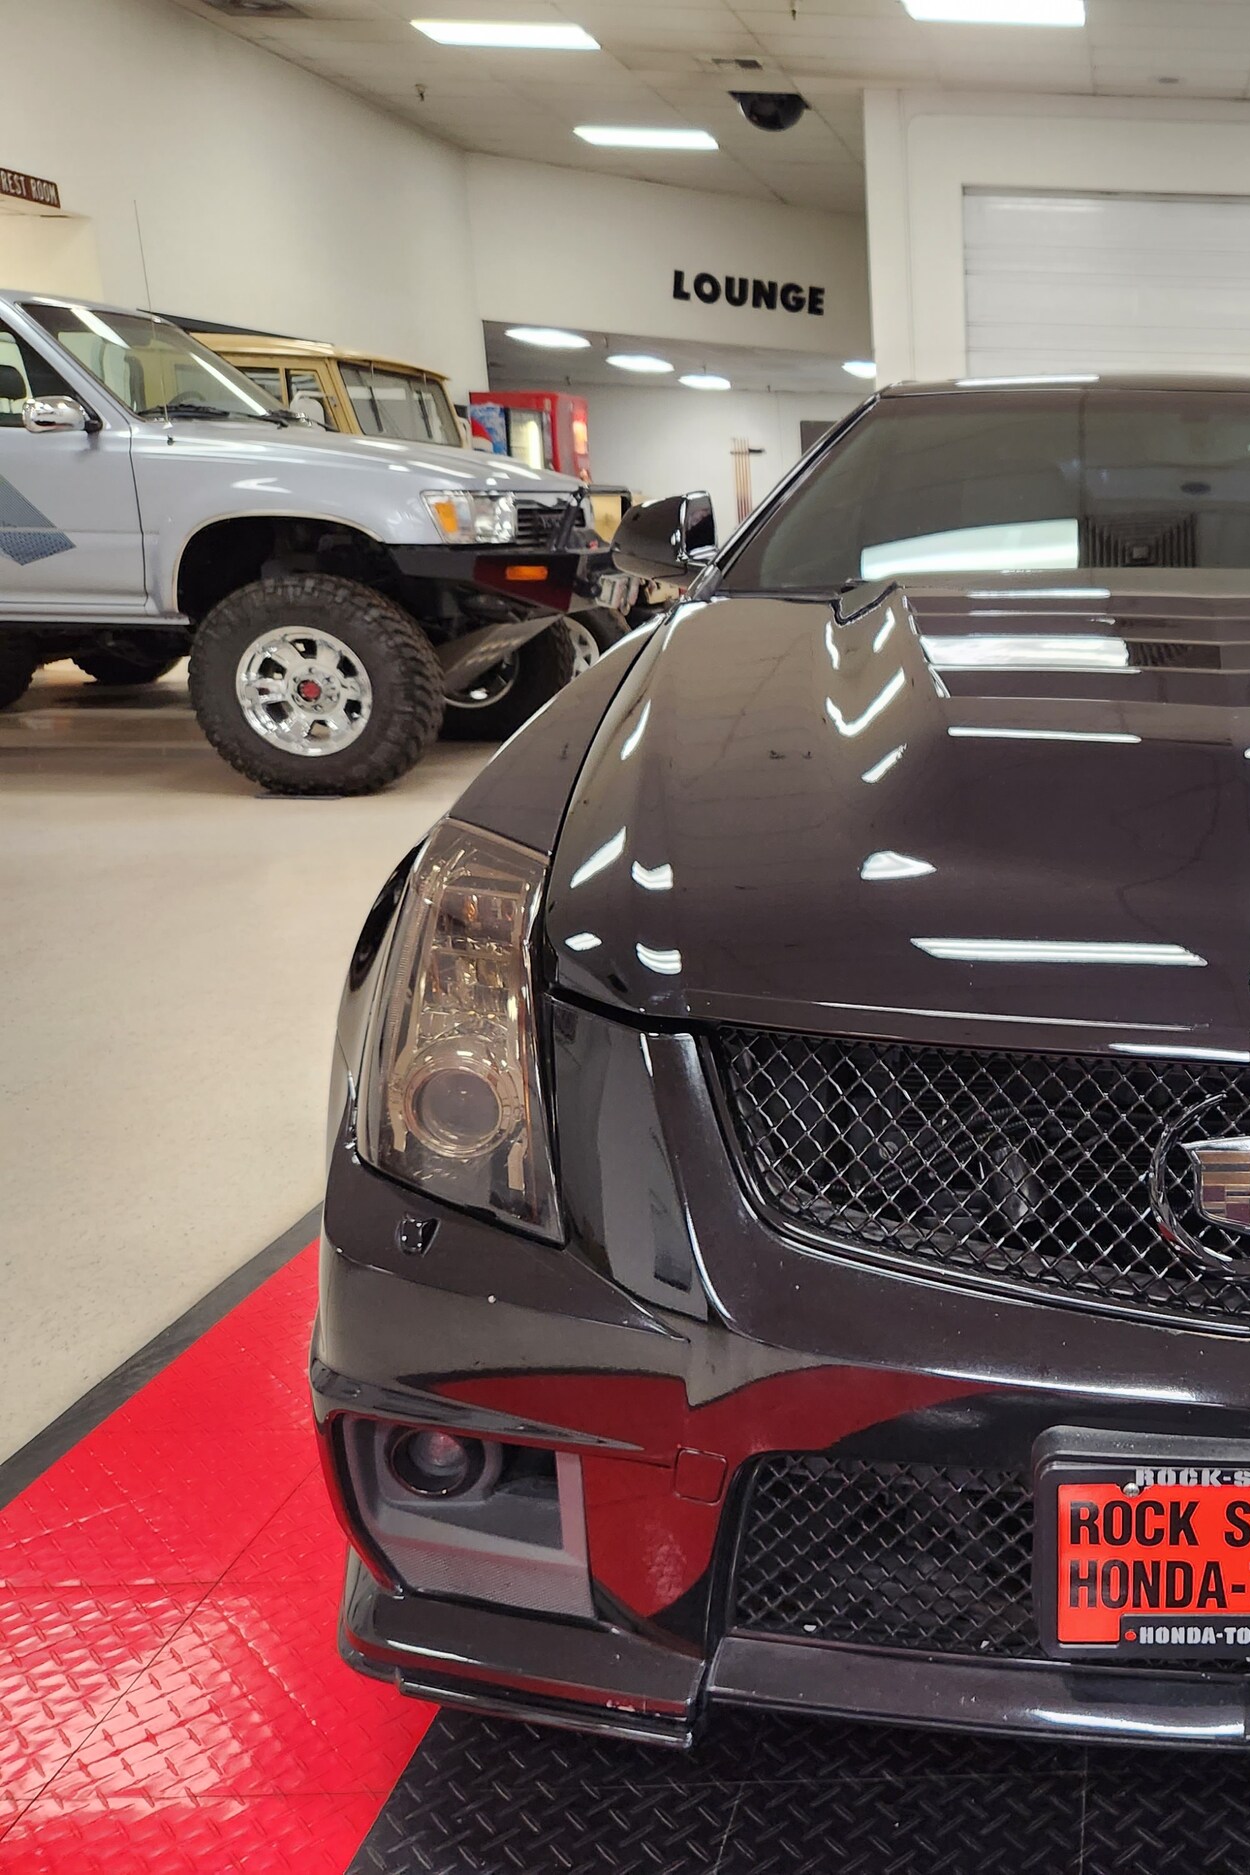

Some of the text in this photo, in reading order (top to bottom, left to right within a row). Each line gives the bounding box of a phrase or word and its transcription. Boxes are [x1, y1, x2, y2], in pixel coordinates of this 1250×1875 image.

[0, 171, 58, 205] REST ROOM
[673, 269, 826, 316] LOUNGE
[1070, 1500, 1199, 1547] ROCK
